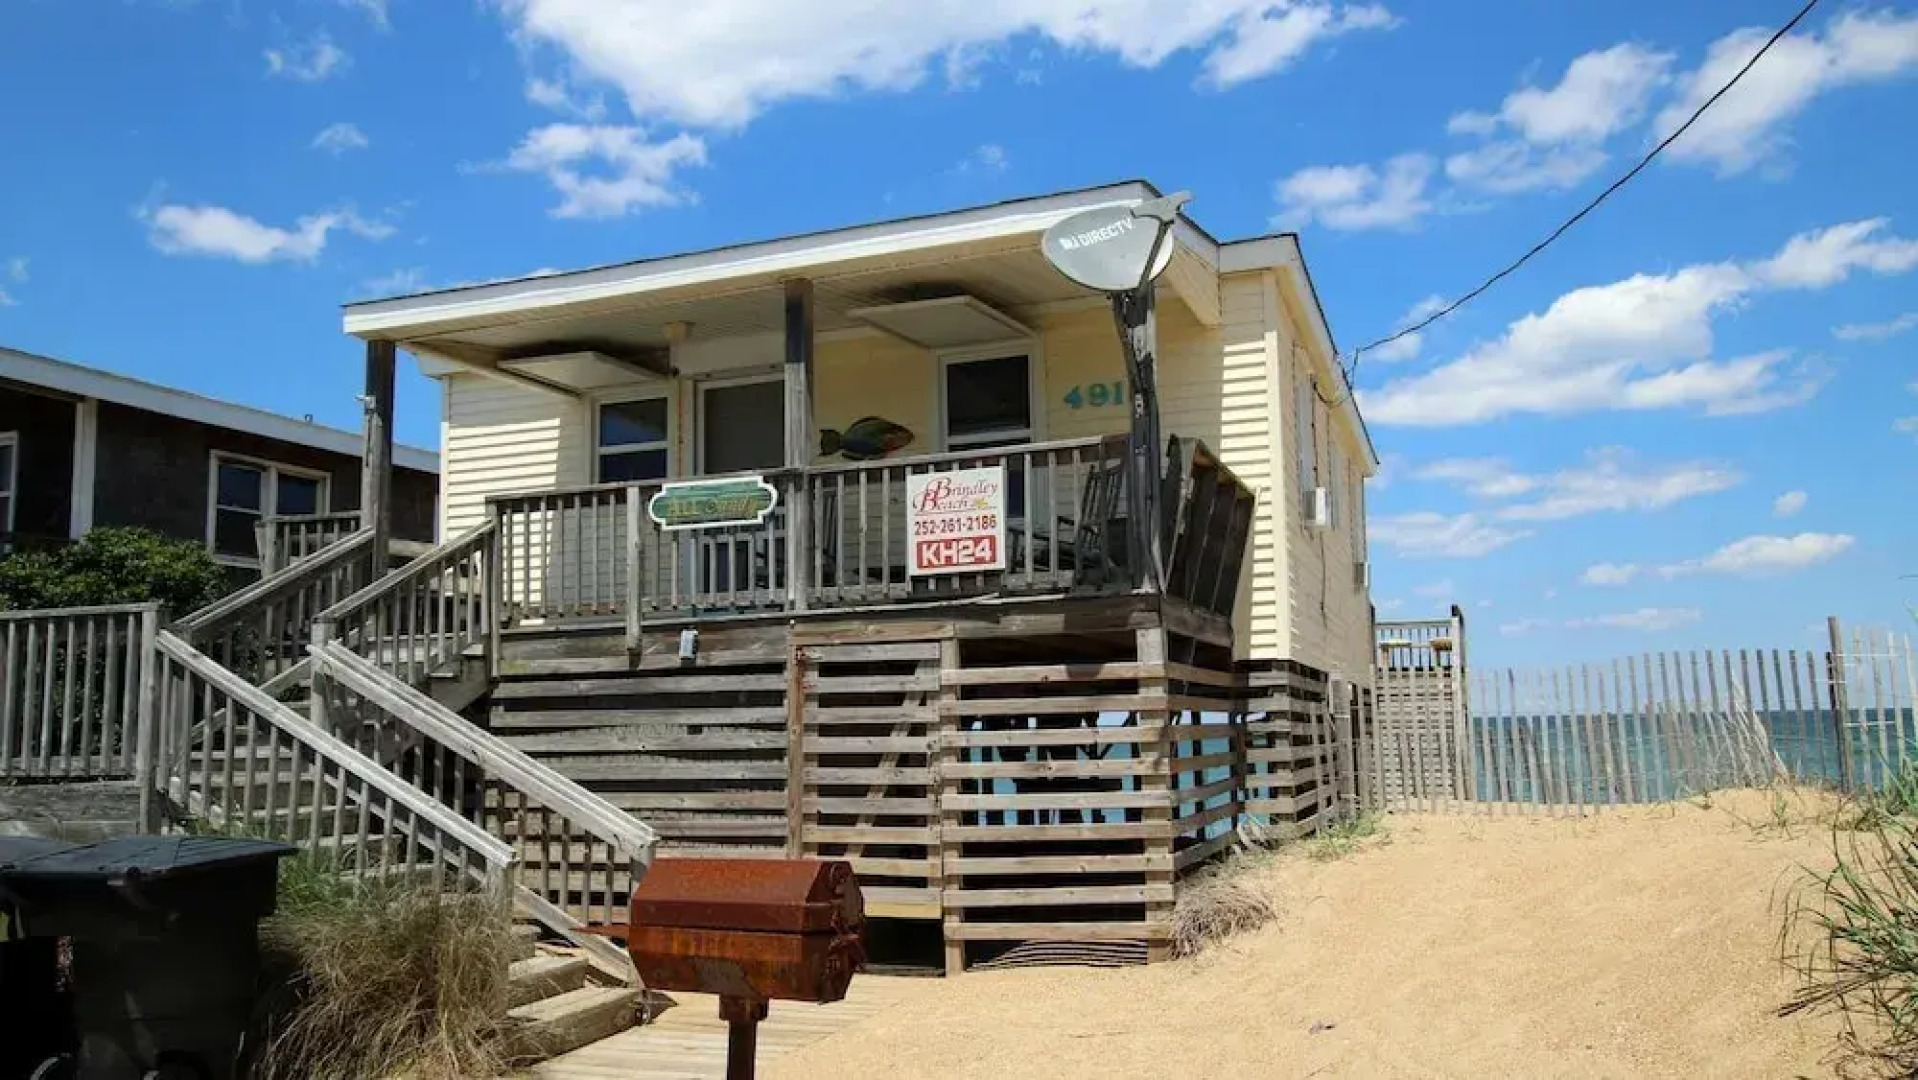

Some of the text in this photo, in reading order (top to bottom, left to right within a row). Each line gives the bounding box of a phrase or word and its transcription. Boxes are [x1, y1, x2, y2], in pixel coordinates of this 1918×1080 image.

[1078, 217, 1134, 247] DIRECTV
[925, 476, 998, 499] Brindley
[913, 490, 968, 511] Beach
[914, 514, 997, 536] 252-261-2186
[921, 538, 993, 566] KH24
